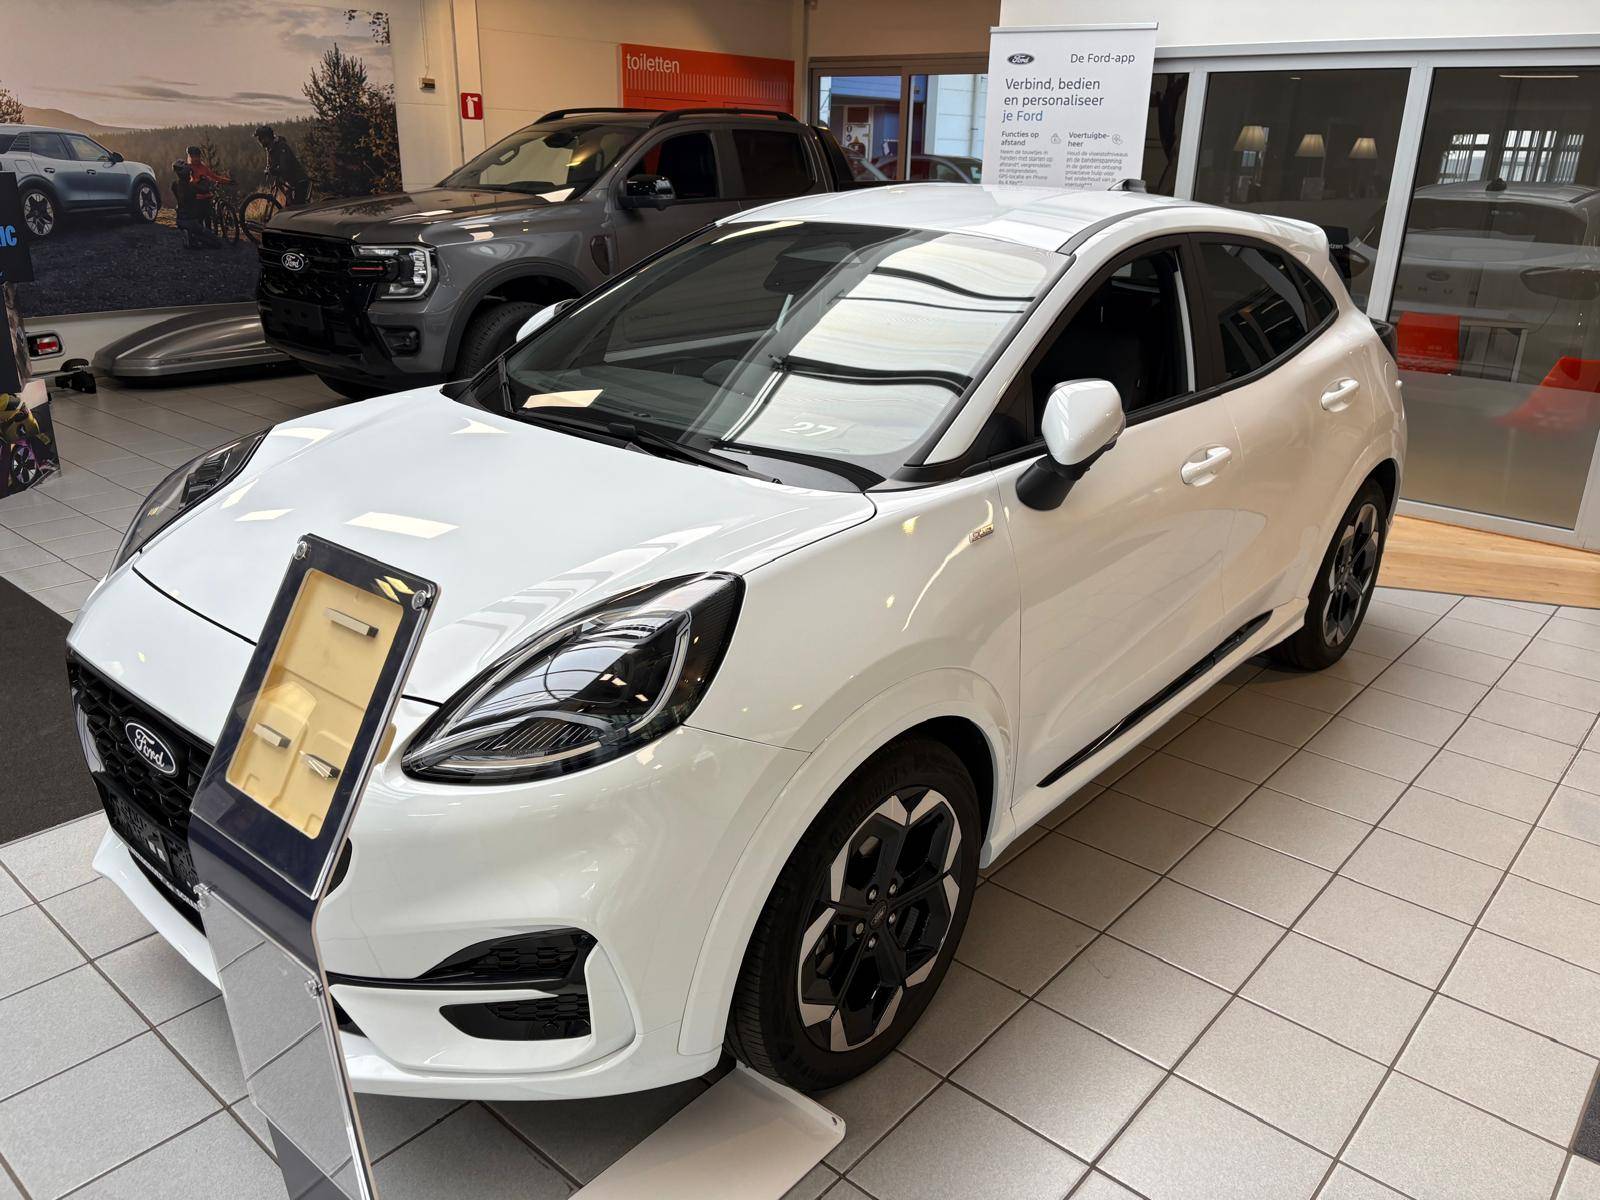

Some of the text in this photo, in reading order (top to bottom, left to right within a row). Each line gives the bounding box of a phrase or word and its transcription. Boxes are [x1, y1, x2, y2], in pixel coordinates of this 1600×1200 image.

[626, 53, 680, 74] toiletten
[1010, 54, 1032, 64] Ford
[1070, 53, 1136, 65] De Ford-app
[1005, 77, 1100, 91] Verbind, bedien
[1004, 94, 1104, 107] en personaliseer
[1001, 110, 1043, 123] je Ford
[1068, 132, 1110, 140] Voertuigbe-
[0, 224, 18, 248] IC
[284, 254, 302, 269] Ford
[132, 727, 168, 769] Ford
